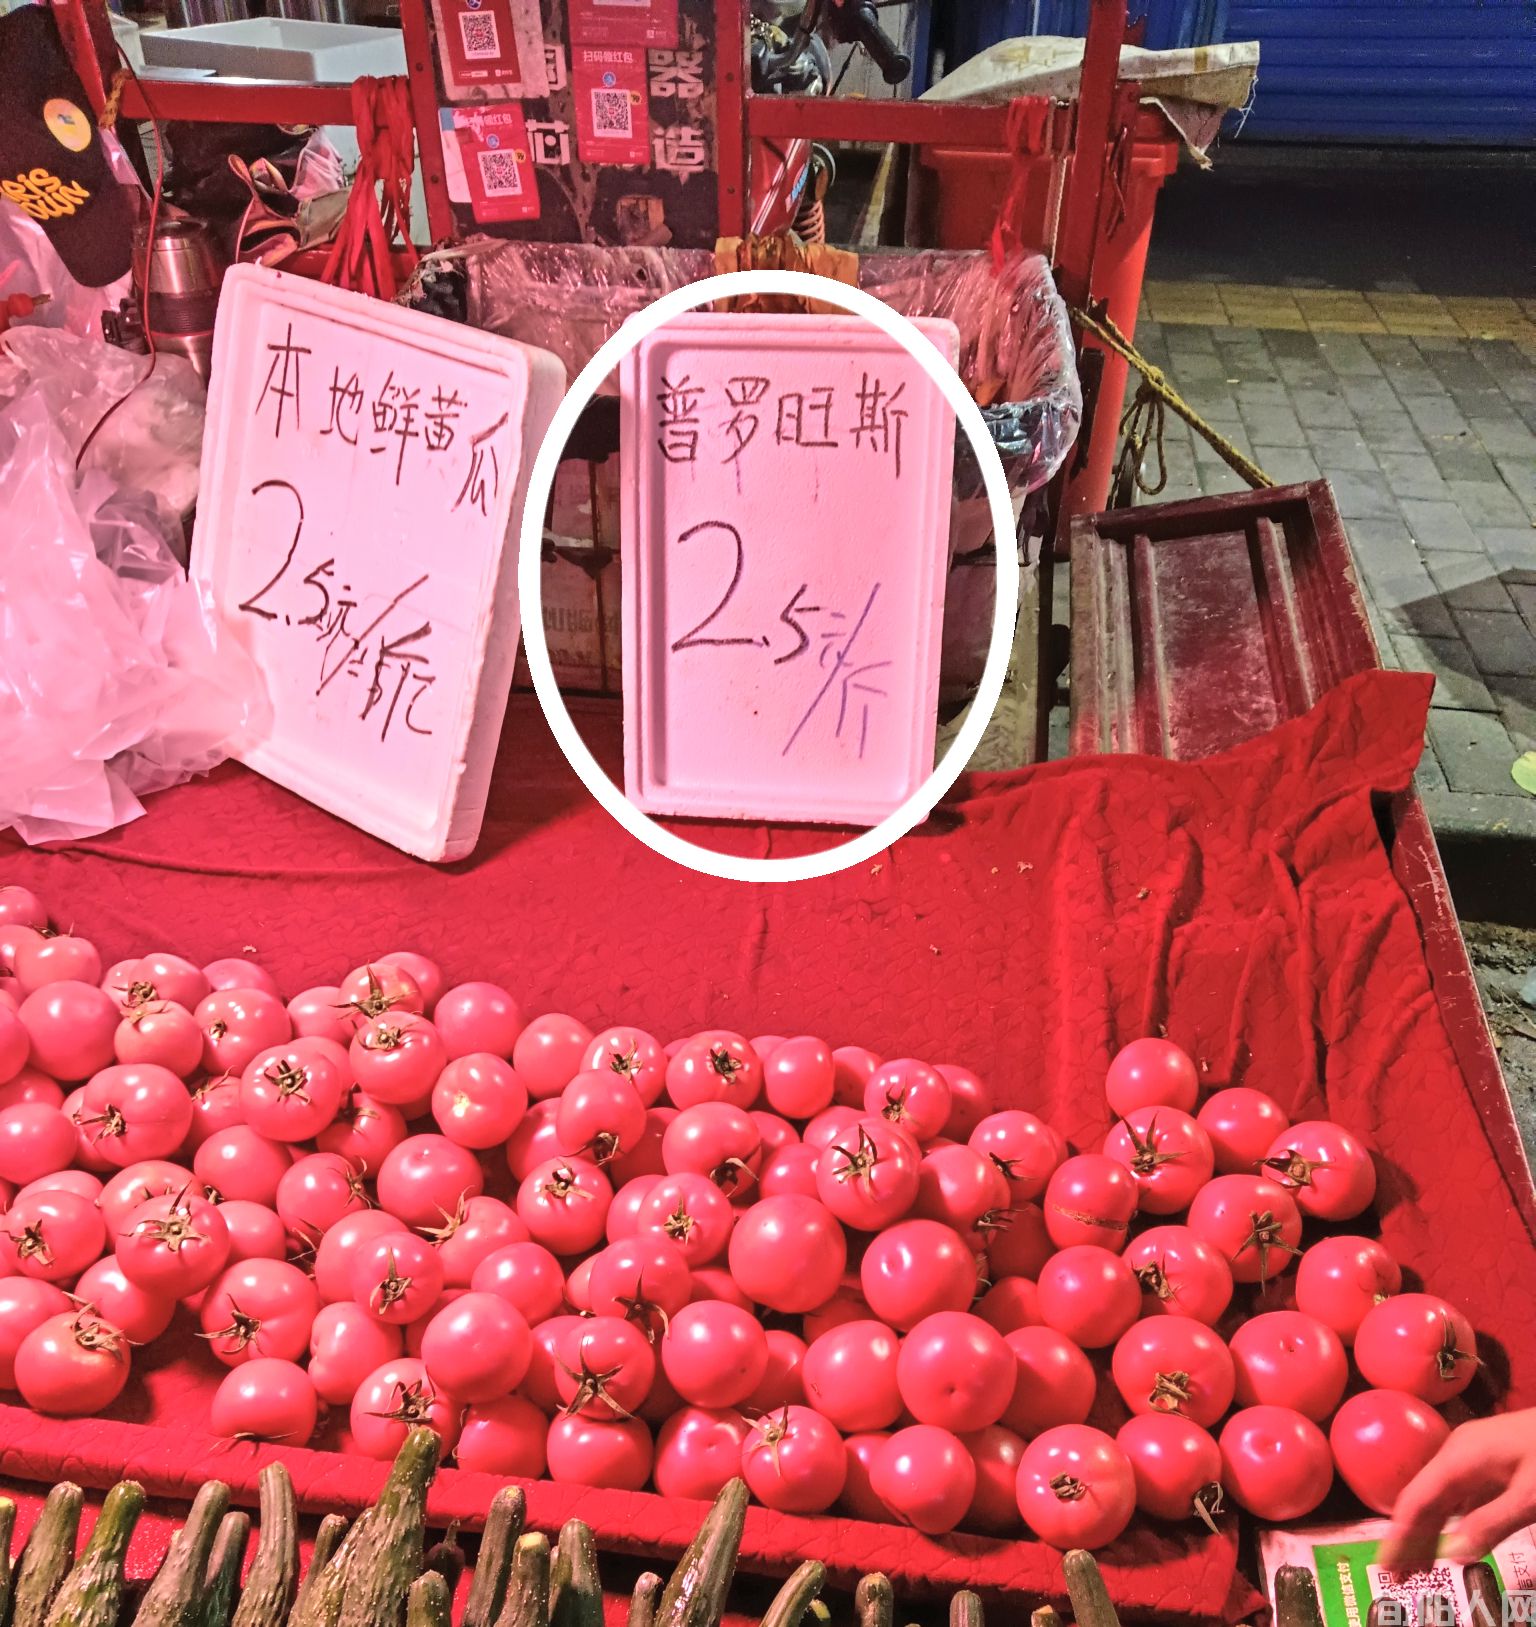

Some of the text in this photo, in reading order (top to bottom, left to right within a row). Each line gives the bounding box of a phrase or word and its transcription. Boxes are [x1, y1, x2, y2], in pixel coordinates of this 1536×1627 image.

[583, 50, 633, 63] 扫码领红包
[255, 323, 508, 517] 本地鲜黄瓜
[656, 371, 910, 480] 普罗旺斯
